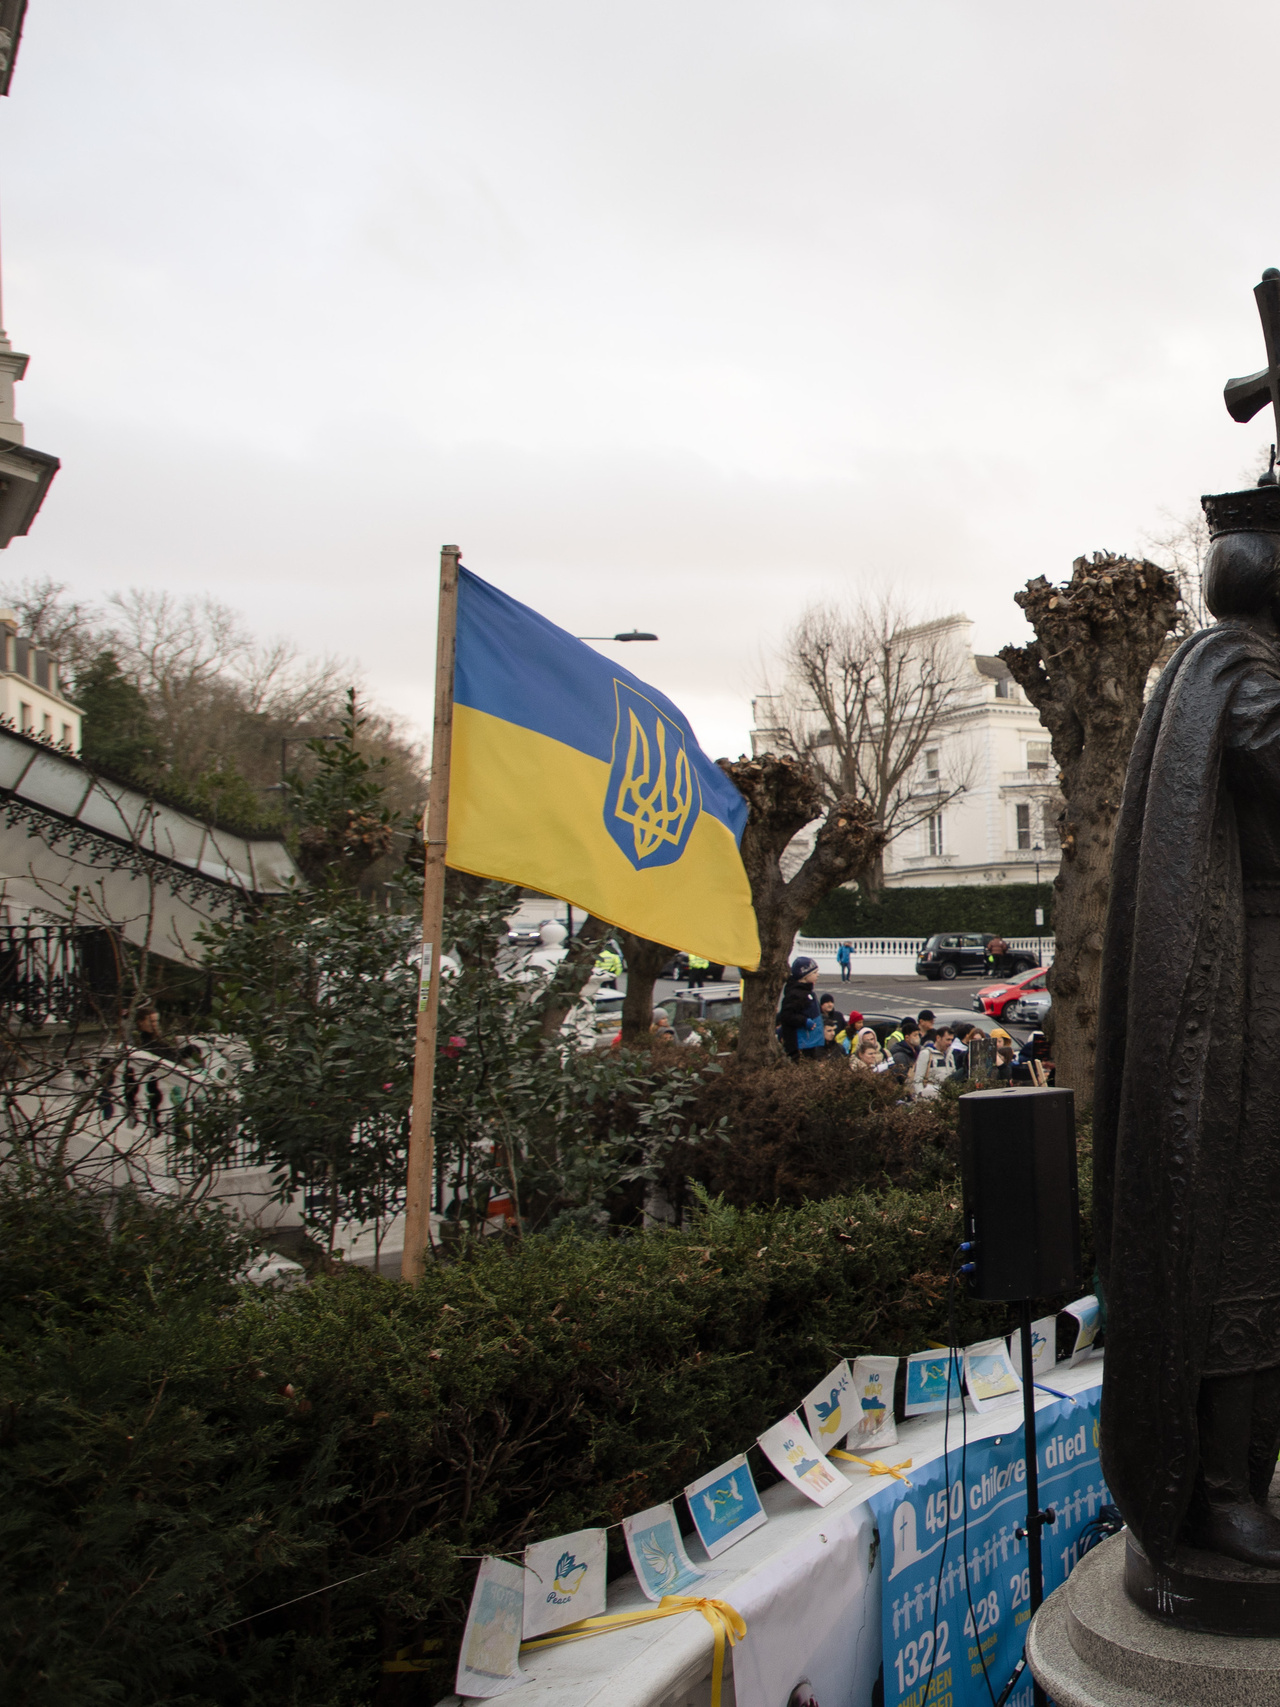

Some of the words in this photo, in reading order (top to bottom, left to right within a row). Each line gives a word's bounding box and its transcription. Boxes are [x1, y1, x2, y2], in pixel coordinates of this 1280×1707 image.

[869, 1374, 879, 1382] NO
[864, 1384, 883, 1396] WAR
[783, 1439, 794, 1451] NO
[787, 1445, 806, 1464] WAR
[926, 1480, 964, 1534] 450
[970, 1454, 1039, 1511] childre
[1046, 1426, 1086, 1469] died
[1010, 1564, 1045, 1610] 26
[546, 1591, 571, 1604] Peace
[963, 1590, 1000, 1638] 428
[894, 1620, 950, 1694] 1322
